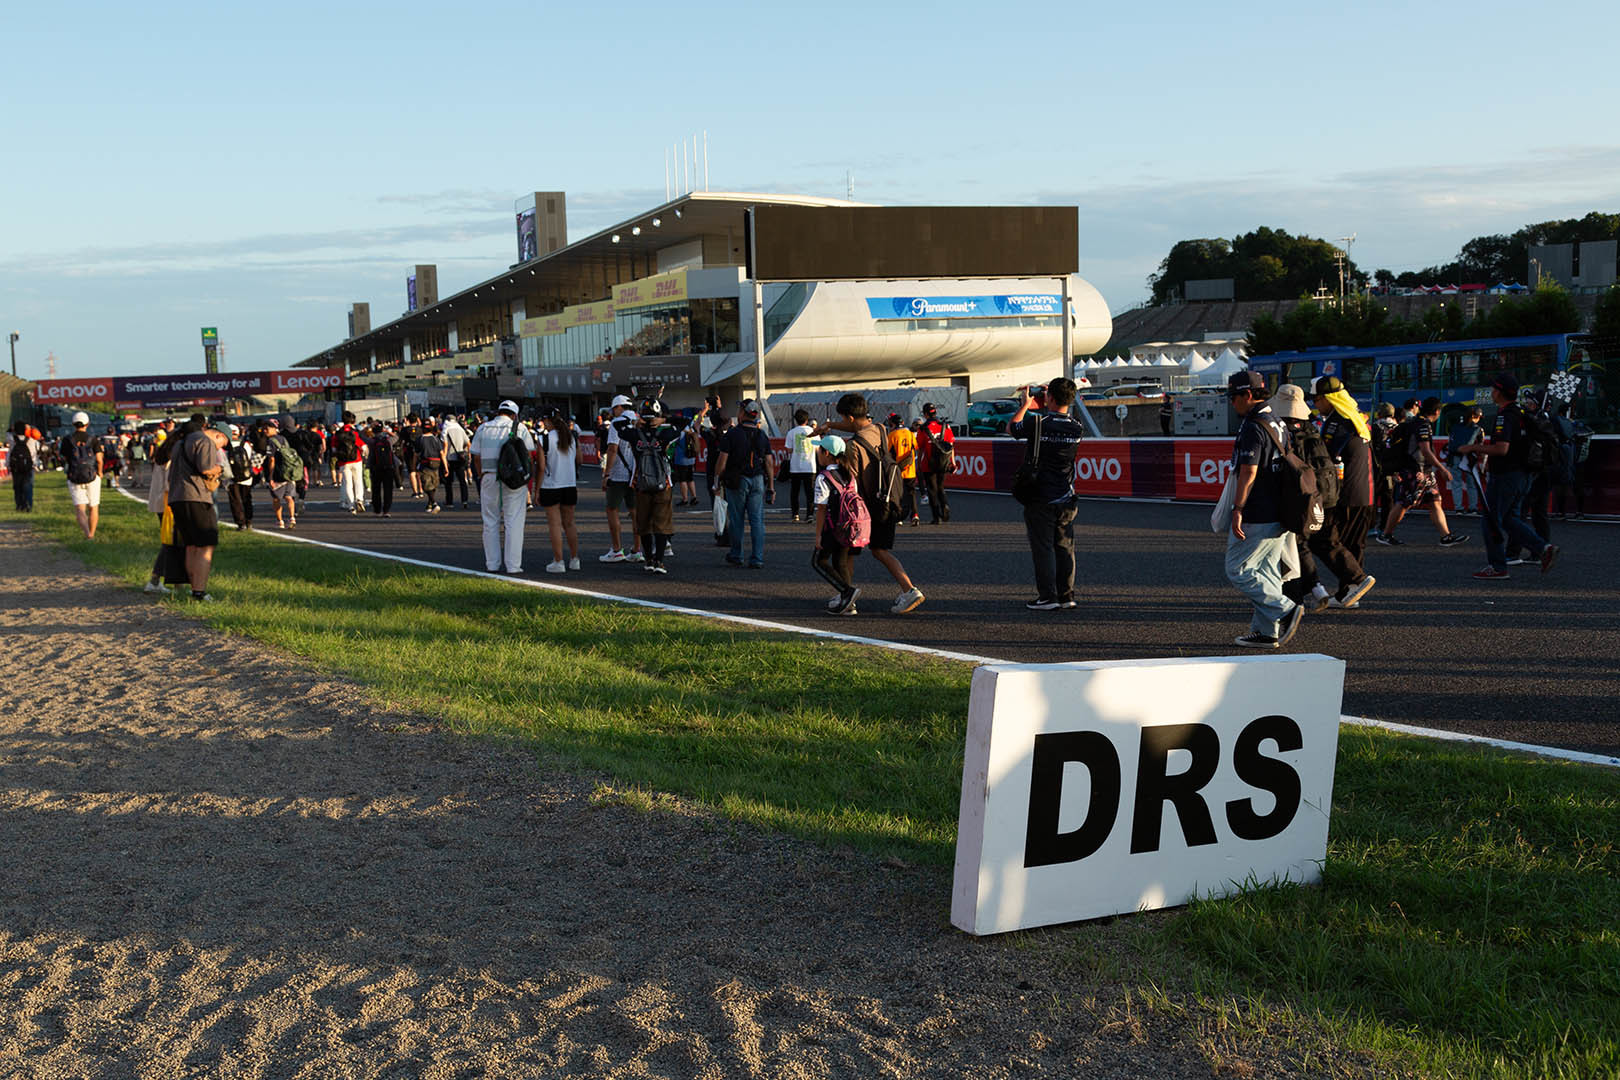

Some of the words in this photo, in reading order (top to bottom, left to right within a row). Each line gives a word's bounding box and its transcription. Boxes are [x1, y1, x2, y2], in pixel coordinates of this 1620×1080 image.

[37, 384, 107, 399] Lenovo
[125, 382, 169, 393] Smarter
[171, 379, 230, 391] technology
[231, 378, 247, 388] for
[248, 378, 261, 388] all
[277, 375, 341, 389] Lenovo
[955, 455, 987, 477] ovo
[1074, 457, 1122, 481] ovo
[1184, 452, 1233, 484] Len
[1023, 714, 1304, 869] DRS
